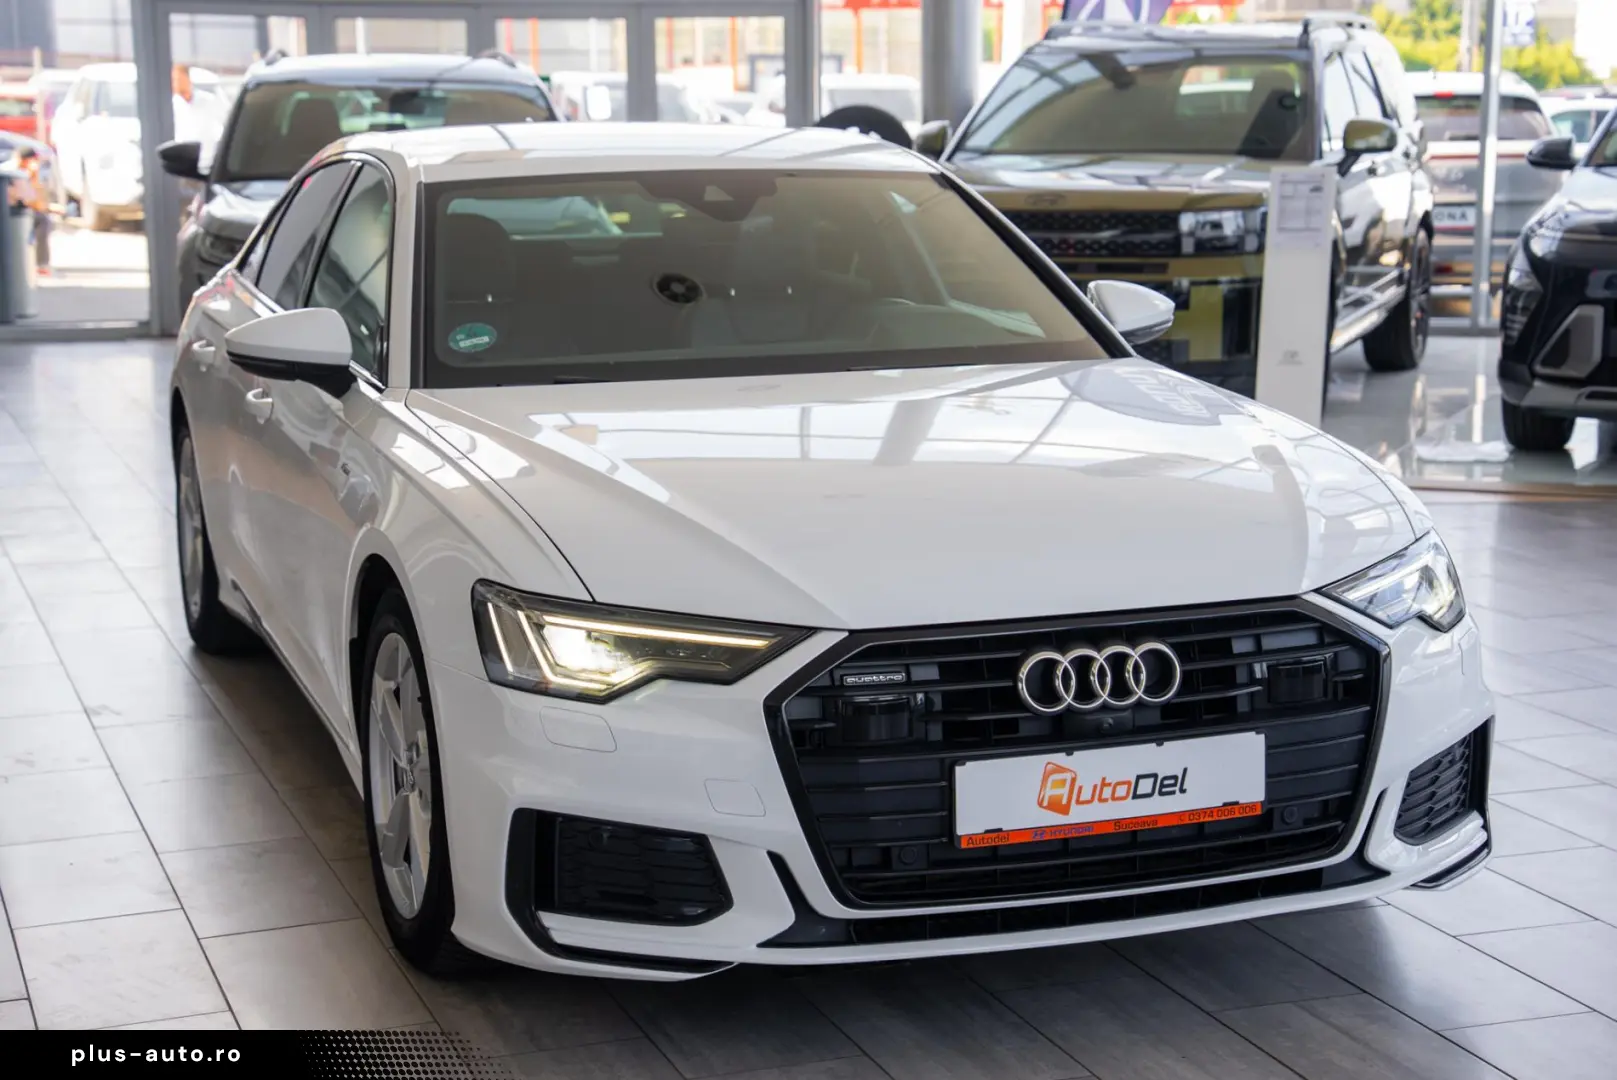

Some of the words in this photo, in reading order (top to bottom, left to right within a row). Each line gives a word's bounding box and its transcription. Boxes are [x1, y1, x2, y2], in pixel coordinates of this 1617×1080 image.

[1434, 211, 1468, 221] ONA
[846, 674, 903, 684] quattro
[1039, 765, 1188, 809] AutoDel
[966, 833, 1010, 846] Autodel
[1113, 819, 1158, 831] Suceava
[1188, 810, 1214, 822] 0374
[1216, 807, 1236, 818] 006
[1238, 804, 1257, 815] 006
